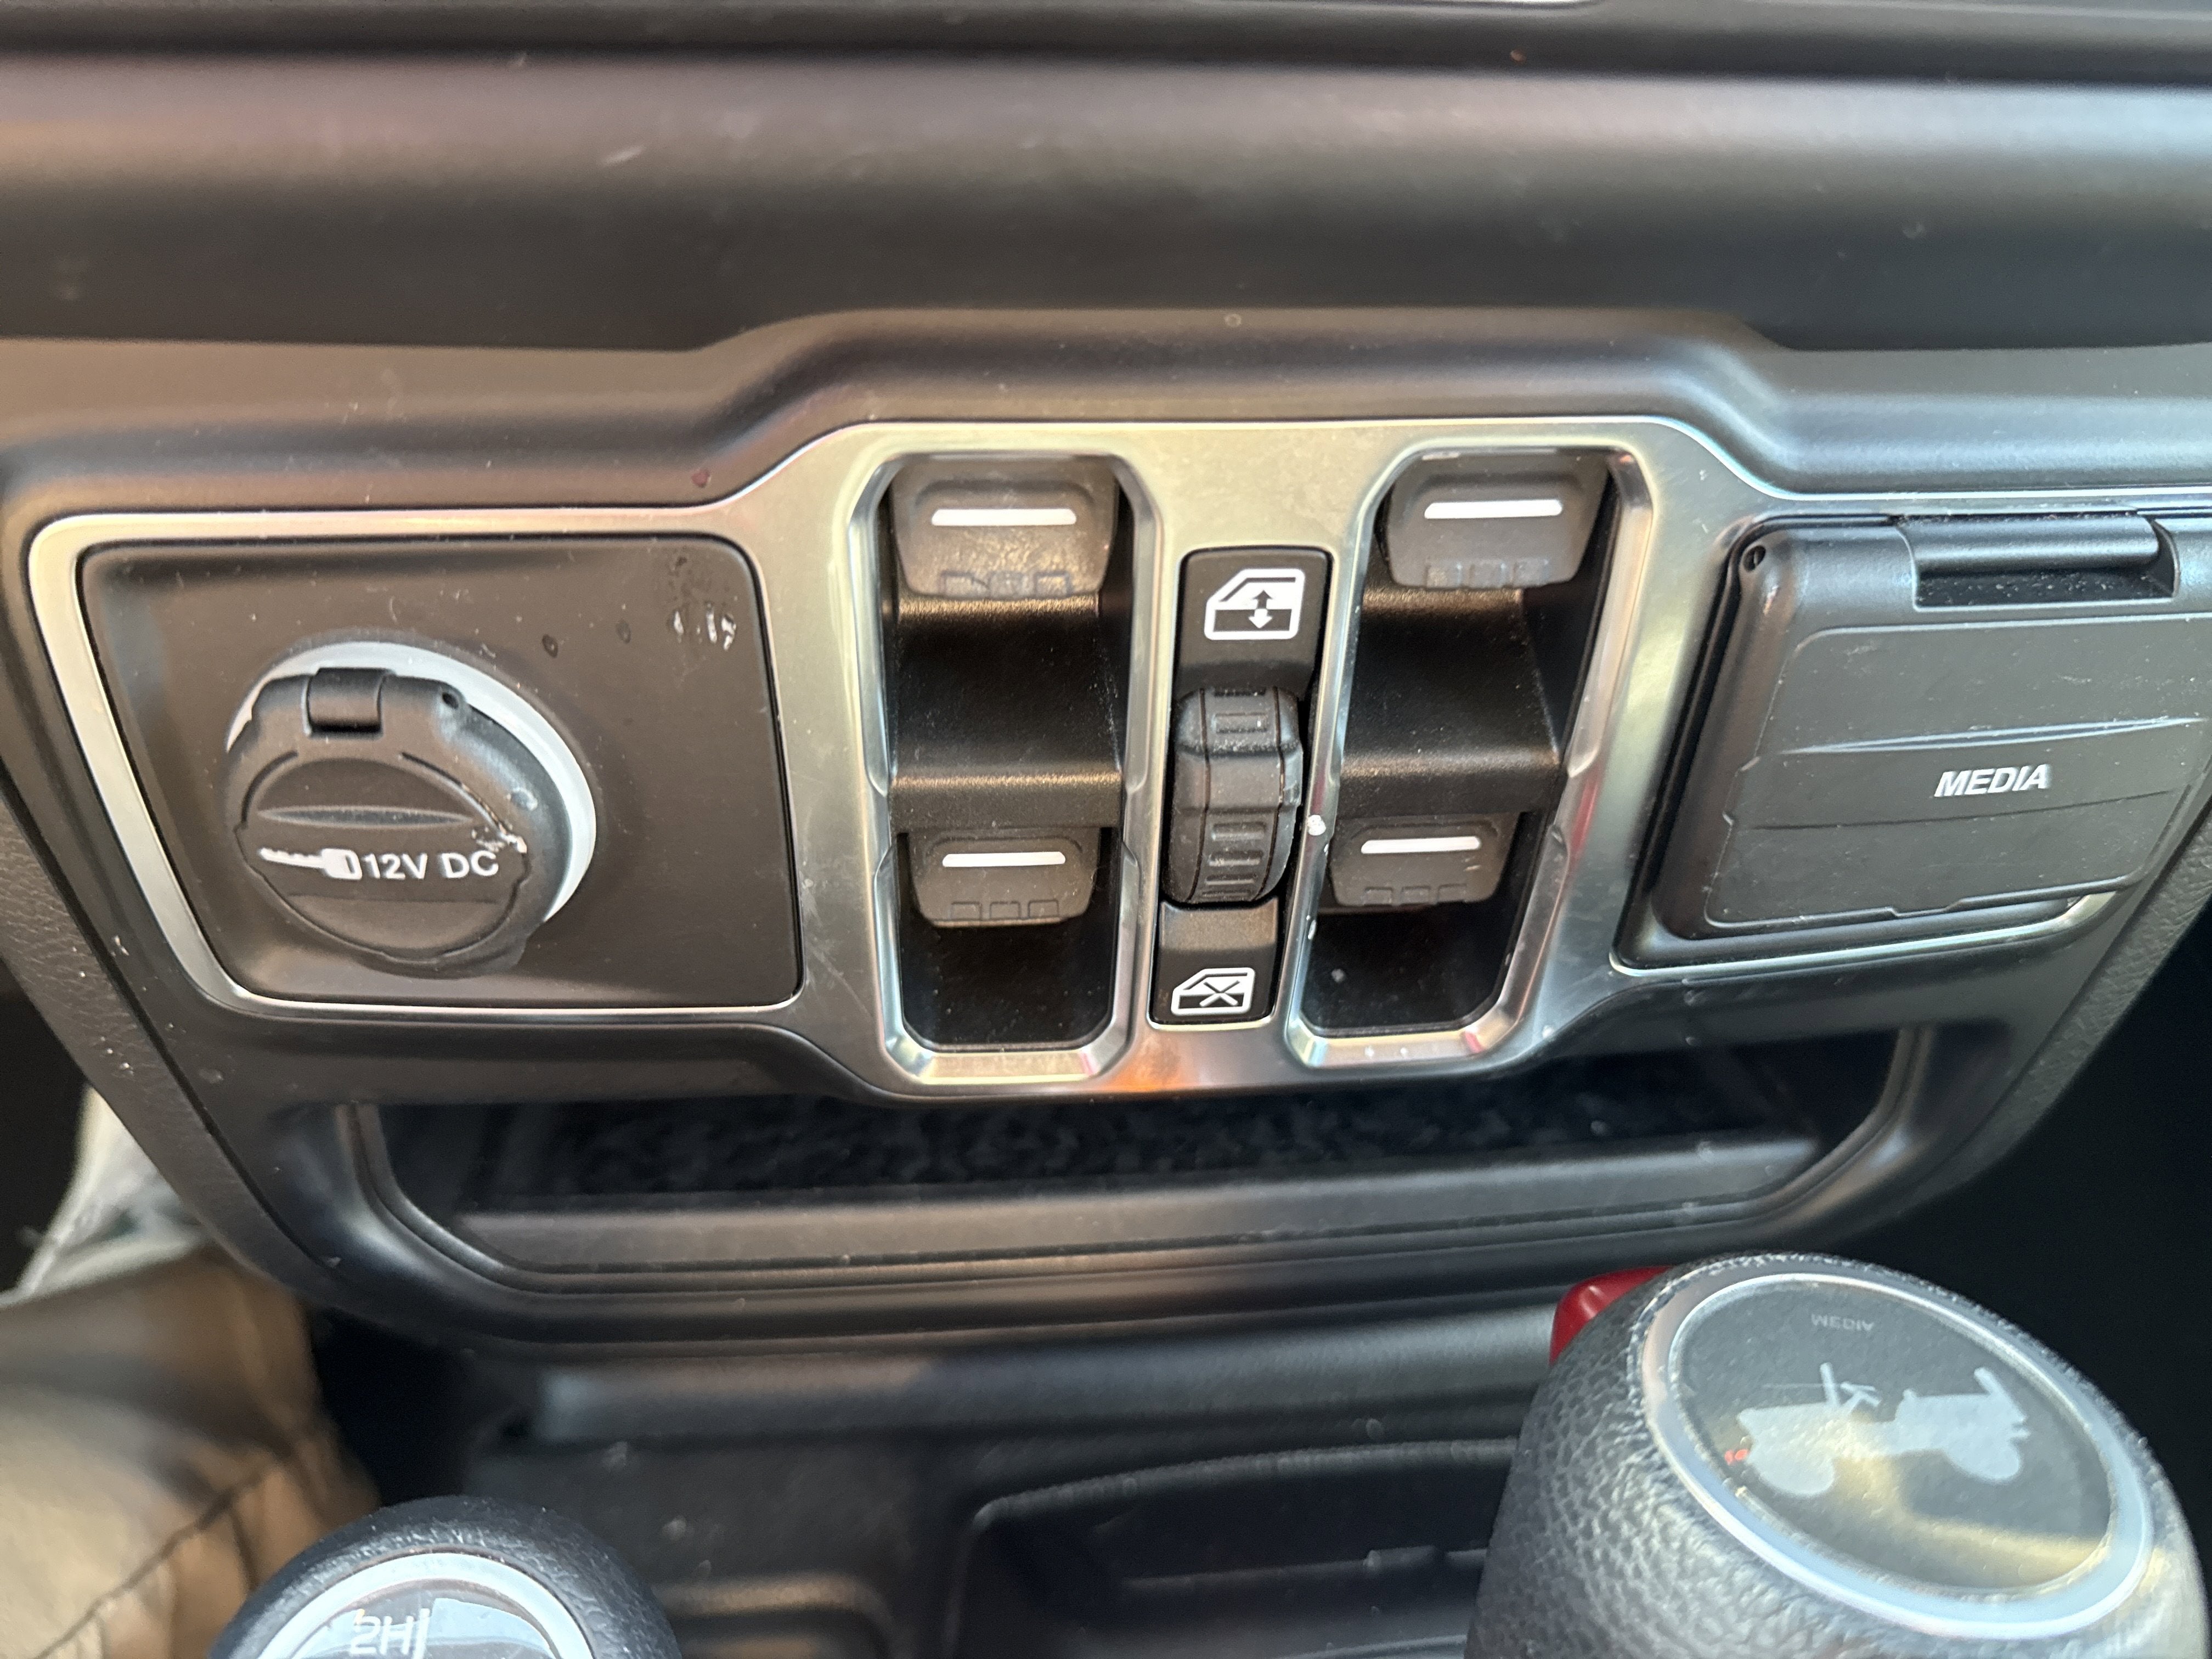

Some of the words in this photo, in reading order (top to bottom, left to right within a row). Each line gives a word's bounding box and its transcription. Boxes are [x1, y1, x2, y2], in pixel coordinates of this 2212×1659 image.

[1934, 764, 2051, 797] MEDIA
[362, 853, 428, 880] 12V
[441, 850, 499, 878] DC
